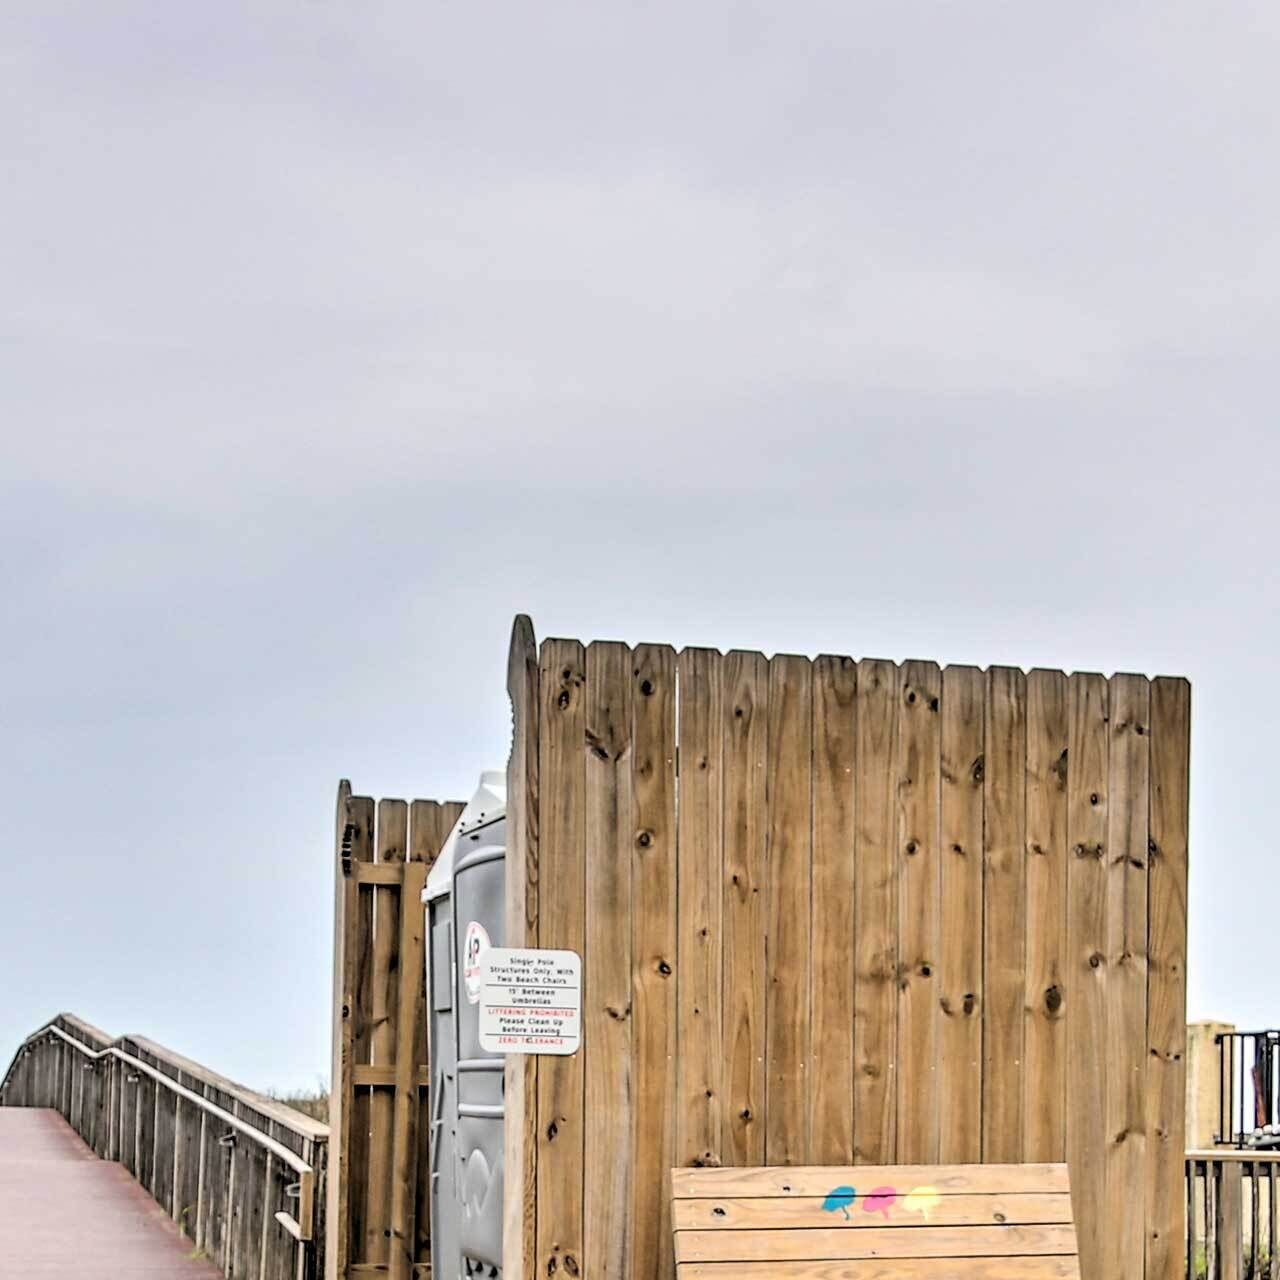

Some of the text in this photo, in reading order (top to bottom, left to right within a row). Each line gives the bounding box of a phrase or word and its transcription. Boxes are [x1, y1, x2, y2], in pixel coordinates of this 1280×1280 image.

[490, 966, 530, 974] Structures
[512, 997, 551, 1005] Umbrellas
[530, 1009, 574, 1017] PROHIBITED
